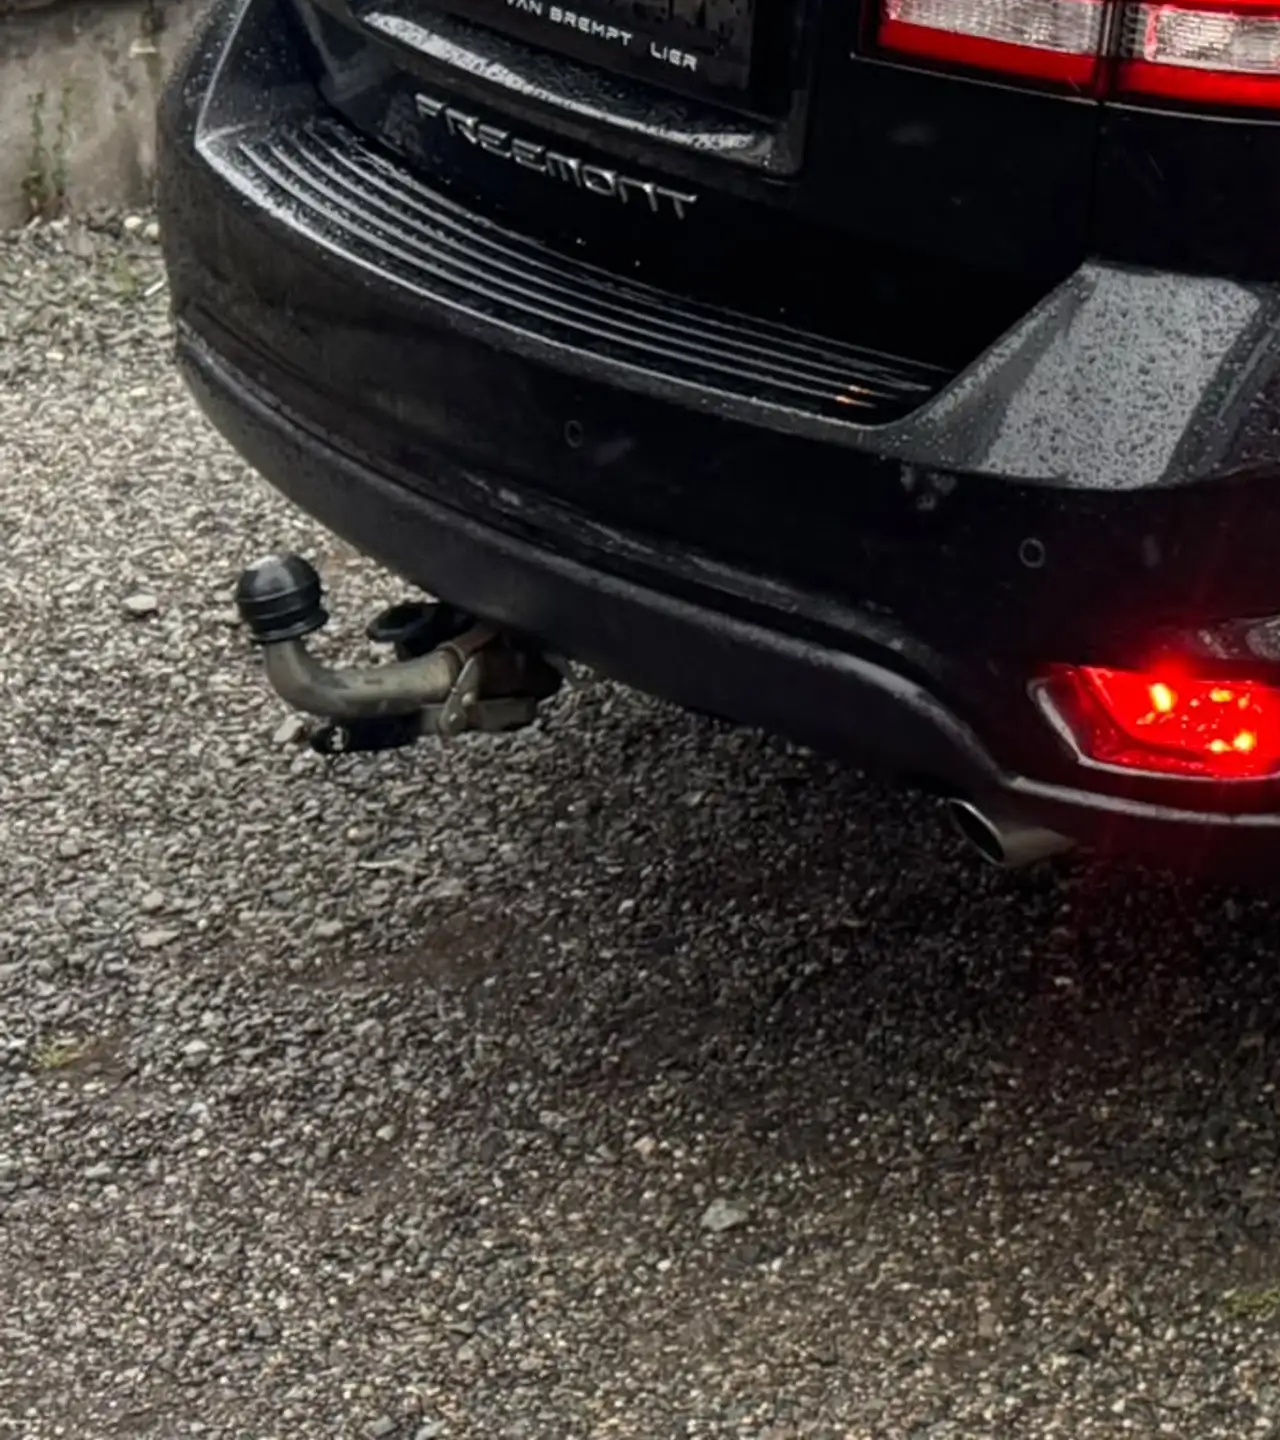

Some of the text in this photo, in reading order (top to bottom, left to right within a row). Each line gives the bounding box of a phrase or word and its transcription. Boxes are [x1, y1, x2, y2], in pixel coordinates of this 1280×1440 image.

[549, 5, 634, 47] BREMPT
[650, 41, 699, 72] LIER
[415, 92, 698, 220] FREEMONT
